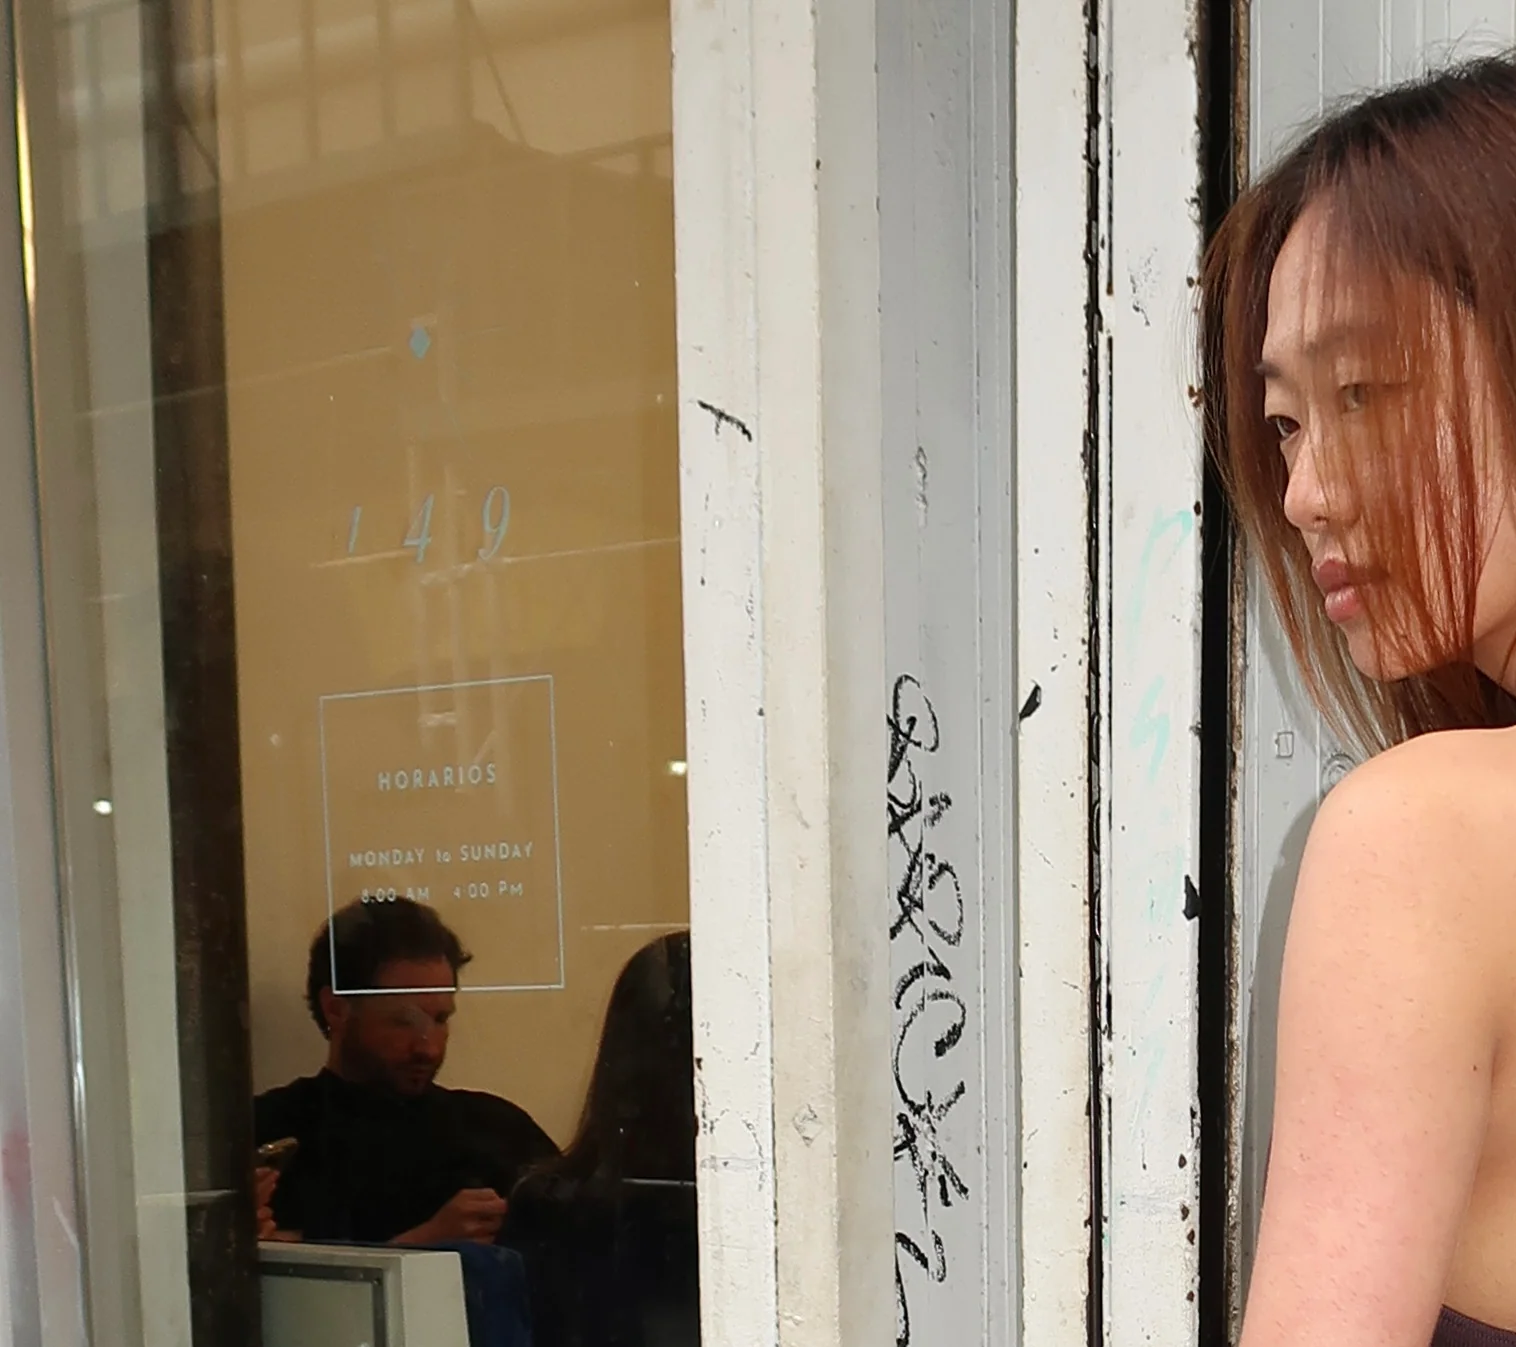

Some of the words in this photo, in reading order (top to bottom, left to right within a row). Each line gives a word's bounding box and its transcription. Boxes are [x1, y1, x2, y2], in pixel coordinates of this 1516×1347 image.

[378, 763, 496, 791] HORARIOS
[349, 848, 424, 868] MONDAY
[460, 842, 533, 861] SUNDAY
[499, 880, 523, 896] PM
